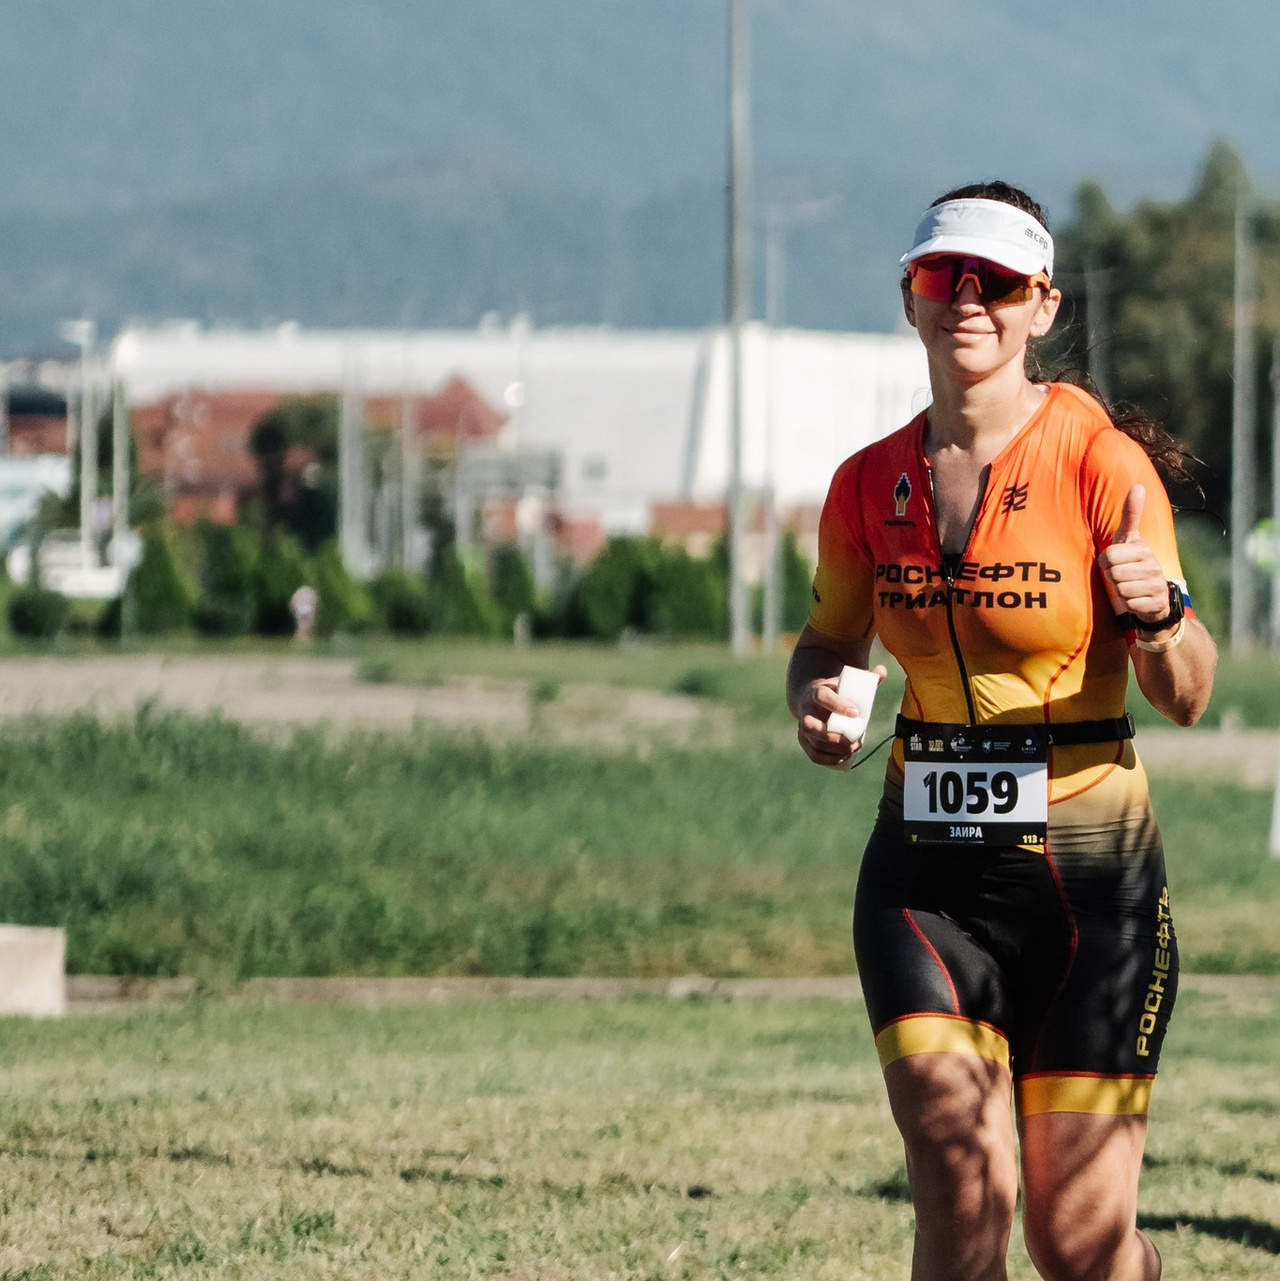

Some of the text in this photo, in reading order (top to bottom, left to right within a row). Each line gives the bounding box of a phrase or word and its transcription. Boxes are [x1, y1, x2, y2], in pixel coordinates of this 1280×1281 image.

[878, 587, 1047, 609] ТРИАТЛОН
[923, 771, 1019, 814] 1059
[950, 826, 983, 838] ЗАИРА
[1022, 835, 1038, 844] 113
[1136, 886, 1171, 1057] РОСНЕФТЬ
